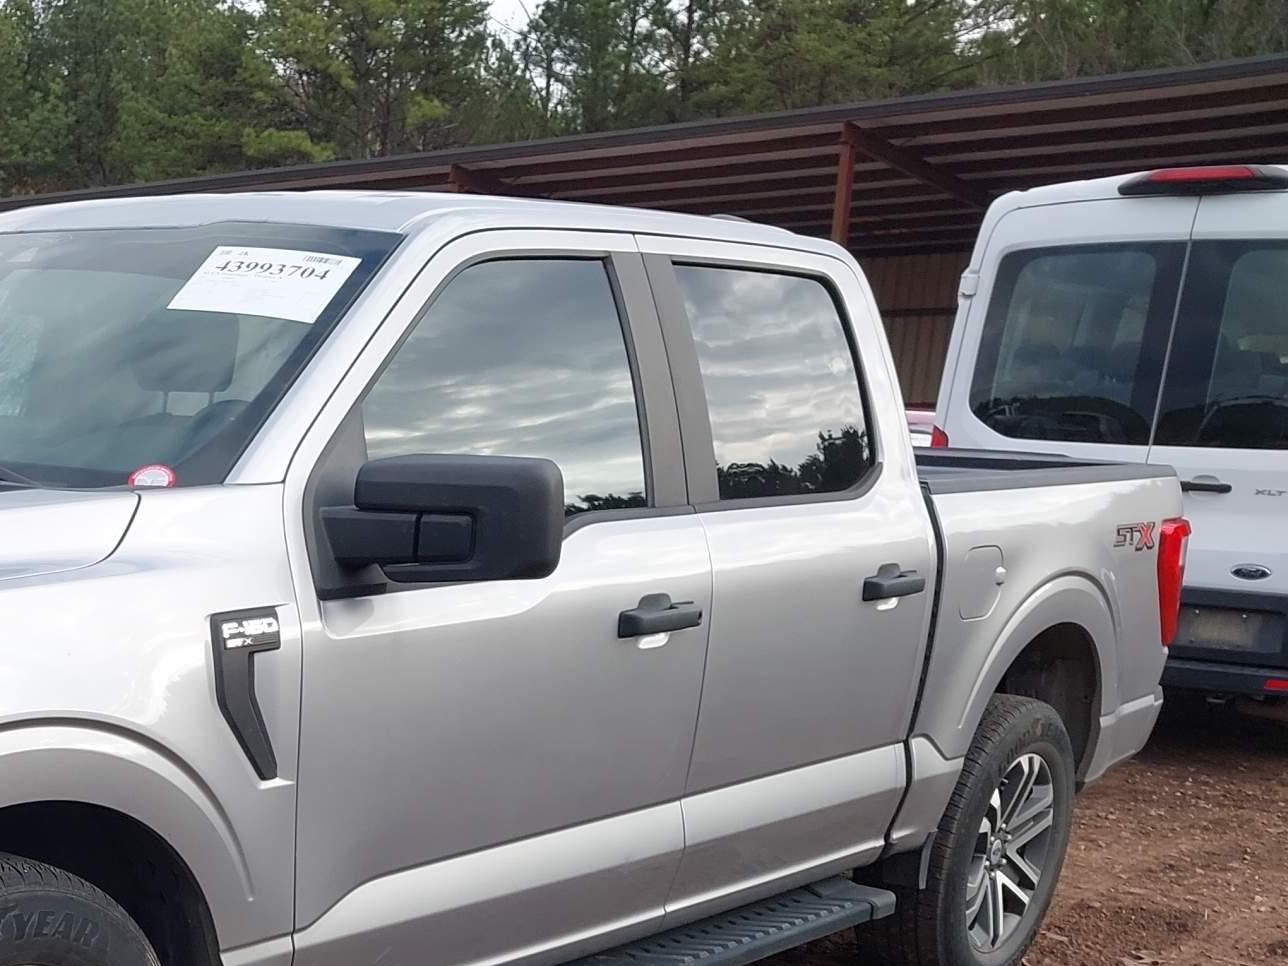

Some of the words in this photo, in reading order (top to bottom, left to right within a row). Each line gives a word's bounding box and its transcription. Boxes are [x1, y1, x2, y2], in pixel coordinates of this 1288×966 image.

[215, 259, 331, 280] 43993704
[1255, 488, 1288, 497] XLT
[1113, 521, 1156, 552] STX
[221, 616, 279, 639] F-150
